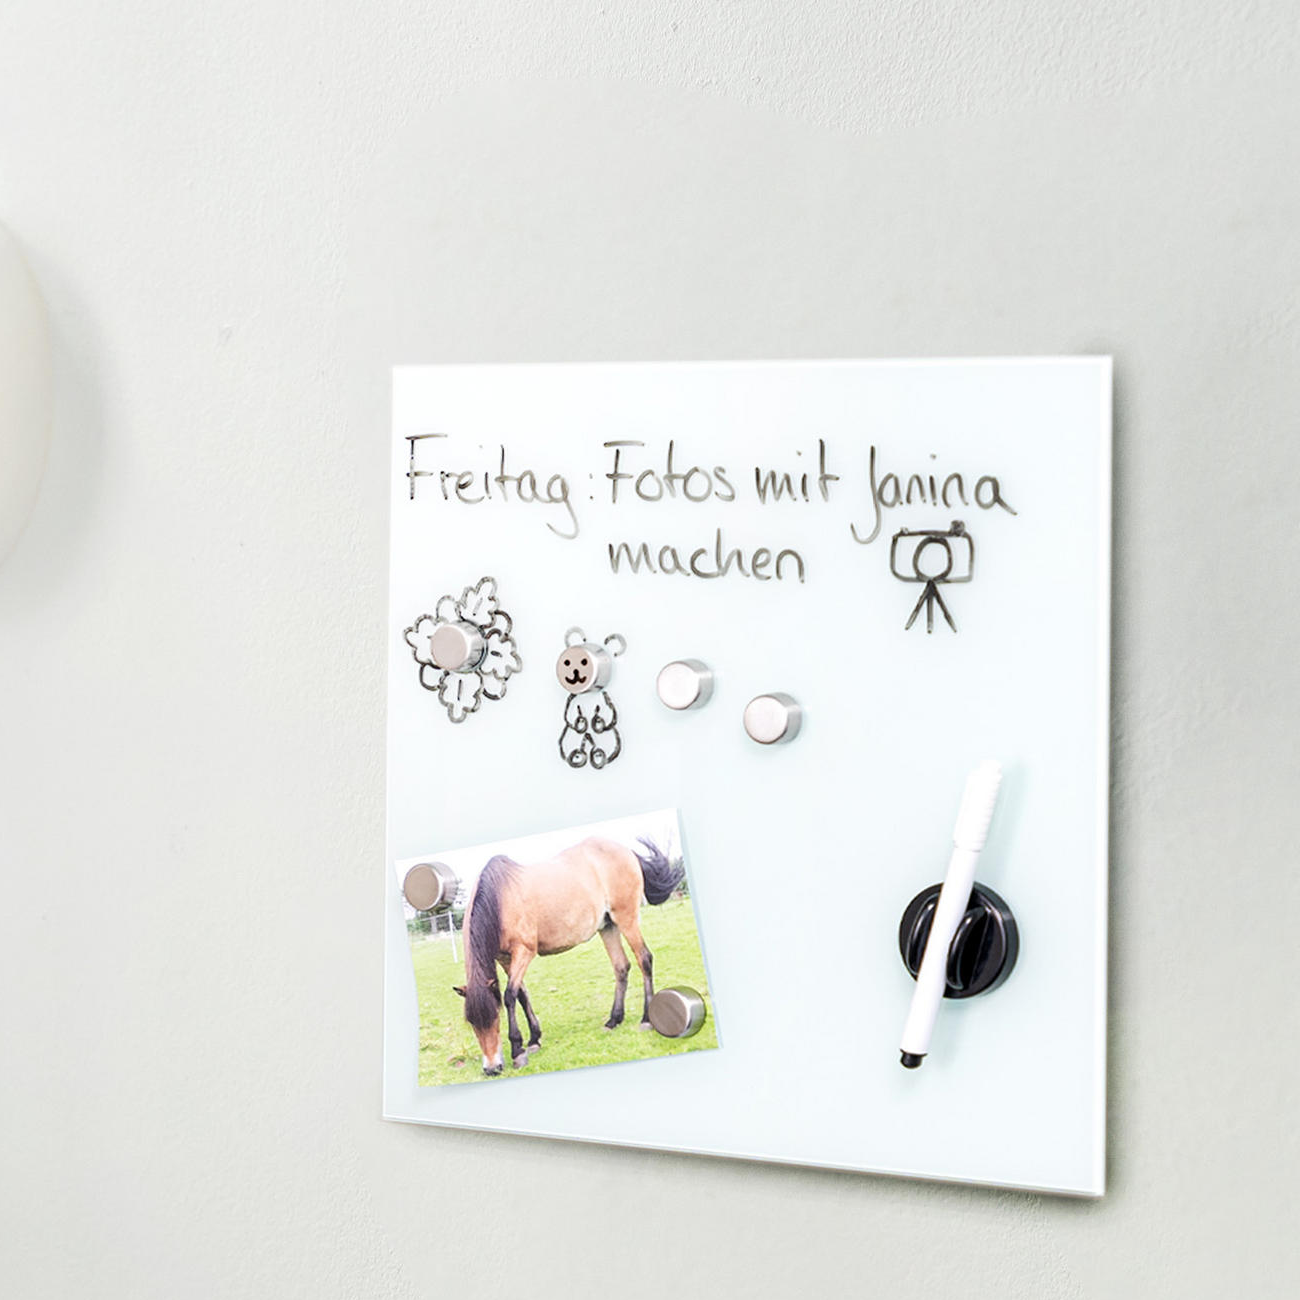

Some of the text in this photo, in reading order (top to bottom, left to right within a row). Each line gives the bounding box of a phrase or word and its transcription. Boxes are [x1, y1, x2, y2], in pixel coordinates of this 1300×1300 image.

[603, 440, 737, 504] Fotos
[754, 438, 841, 504] mit
[849, 444, 1019, 545] Janina
[608, 527, 806, 584] machen
